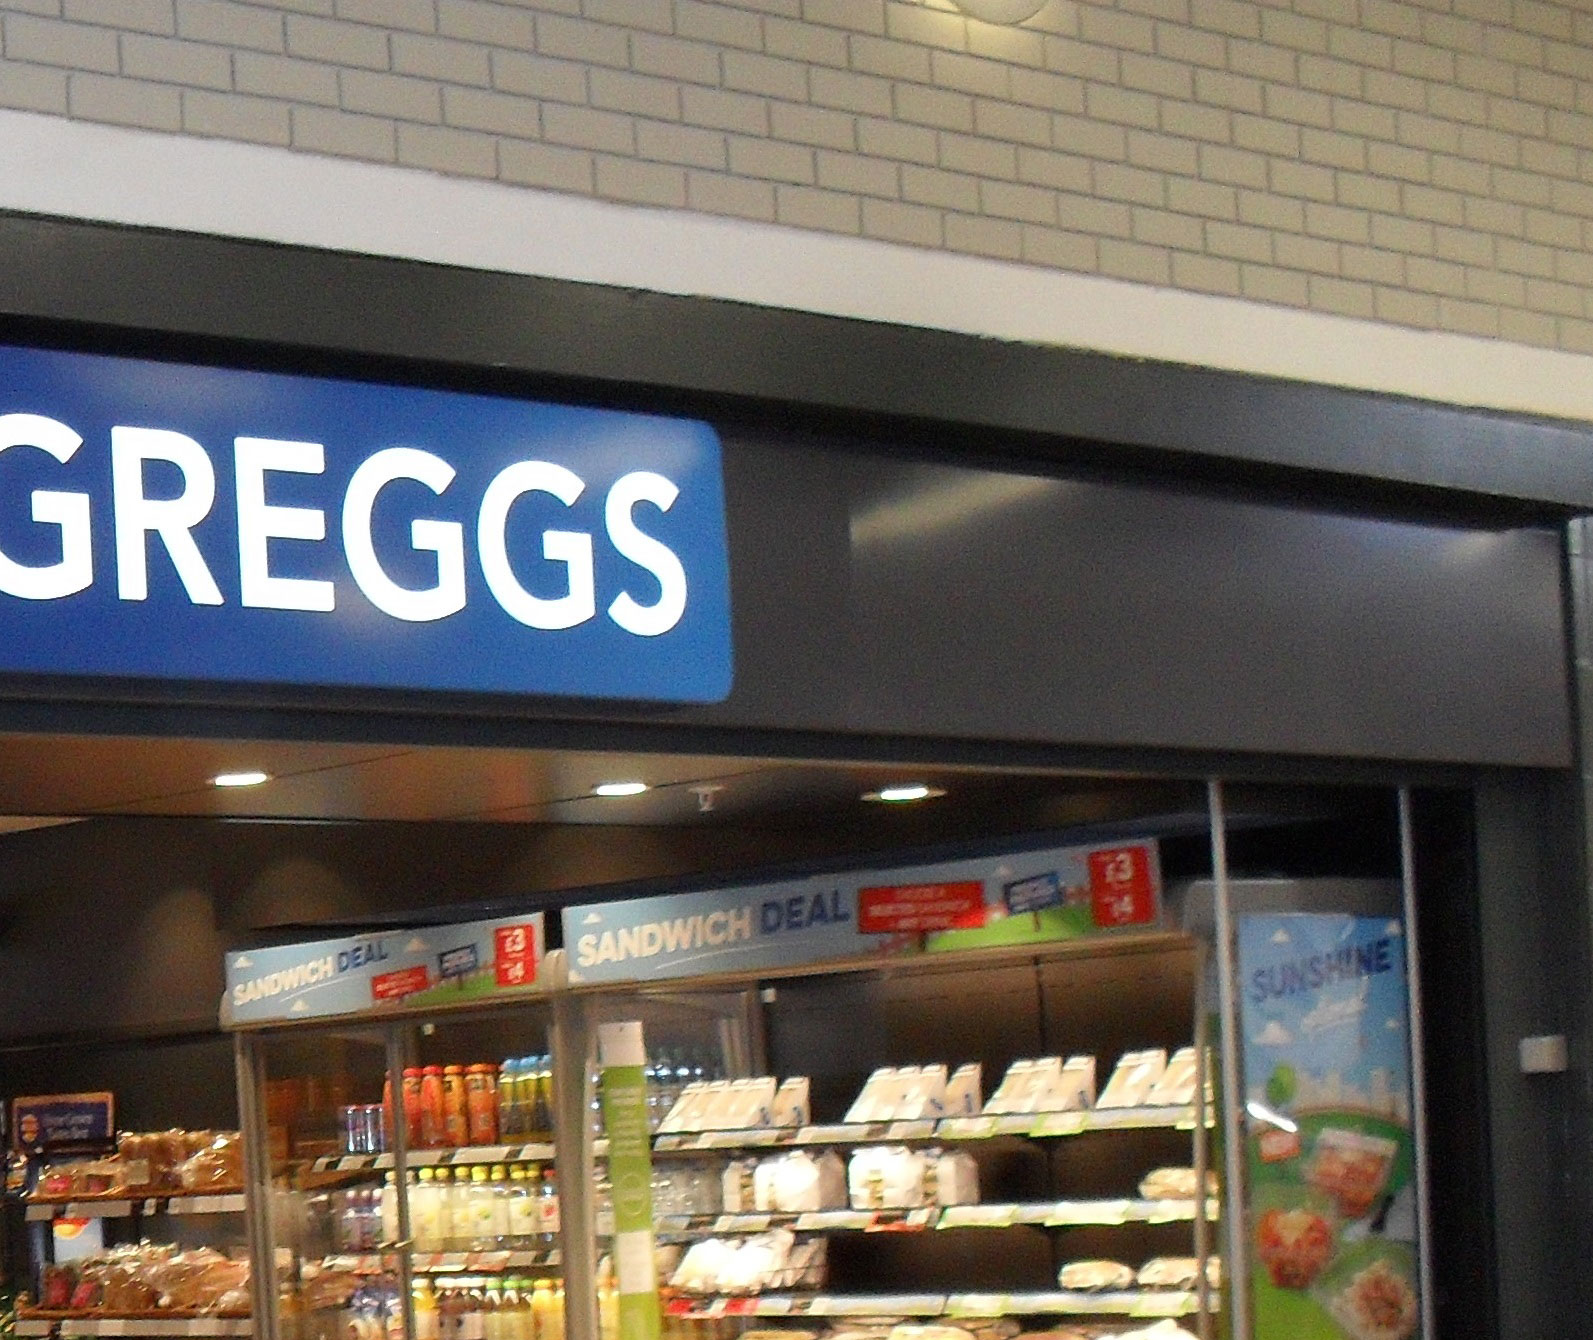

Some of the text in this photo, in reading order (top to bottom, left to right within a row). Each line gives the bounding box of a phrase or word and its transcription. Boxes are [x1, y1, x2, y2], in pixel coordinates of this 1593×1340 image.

[577, 905, 752, 967] SANDWICH
[761, 888, 851, 935] DEAL
[233, 955, 335, 1006] SANDWICH
[337, 940, 389, 974] DEAL
[1252, 937, 1392, 1003] SUNSHINE
